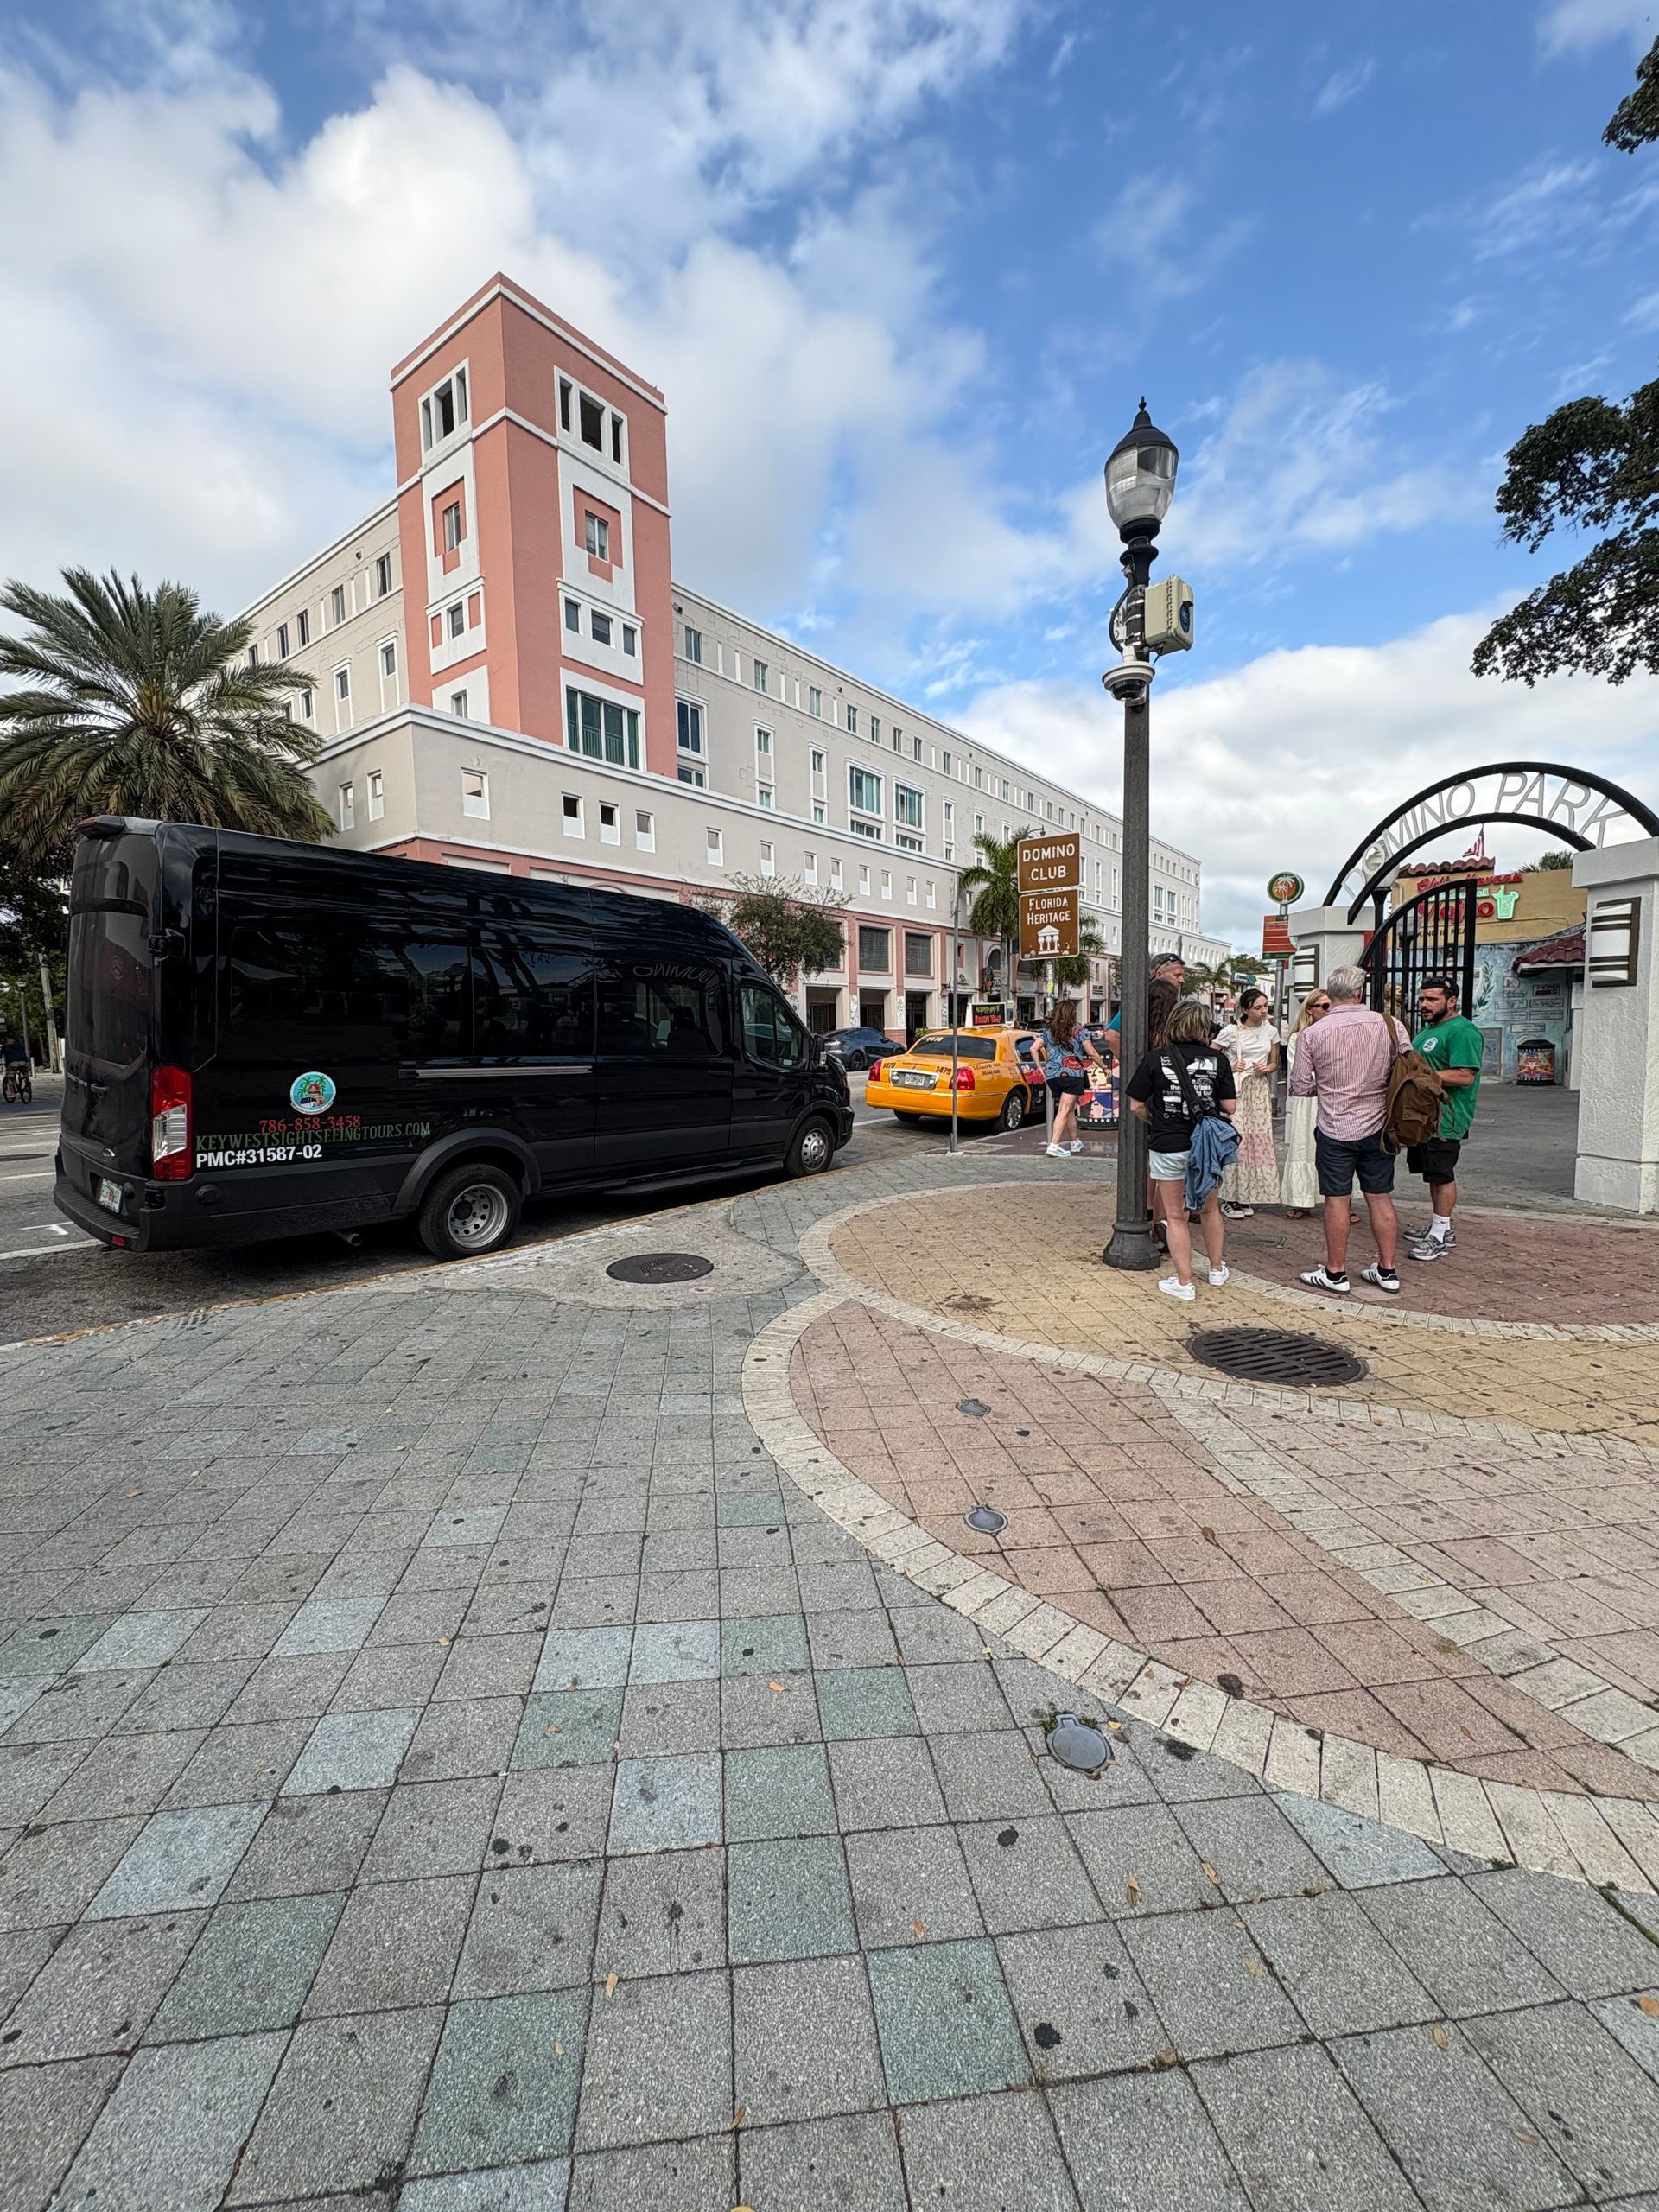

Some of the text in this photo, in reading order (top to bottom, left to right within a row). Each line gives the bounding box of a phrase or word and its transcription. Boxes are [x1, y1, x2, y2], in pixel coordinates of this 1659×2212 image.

[1340, 772, 1629, 900] DOMINO PARK
[1022, 843, 1075, 862] DOMINO
[1031, 865, 1066, 881] CLUB
[1029, 897, 1068, 911] FLORIDA
[1027, 911, 1071, 925] HERITAGE
[936, 1065, 951, 1075] 1479
[259, 1115, 361, 1133] 786-858-3458
[196, 1122, 431, 1151] KEYWESTSIGHTSEEINGTOURS.COM
[196, 1144, 322, 1168] PMC#31587-02
